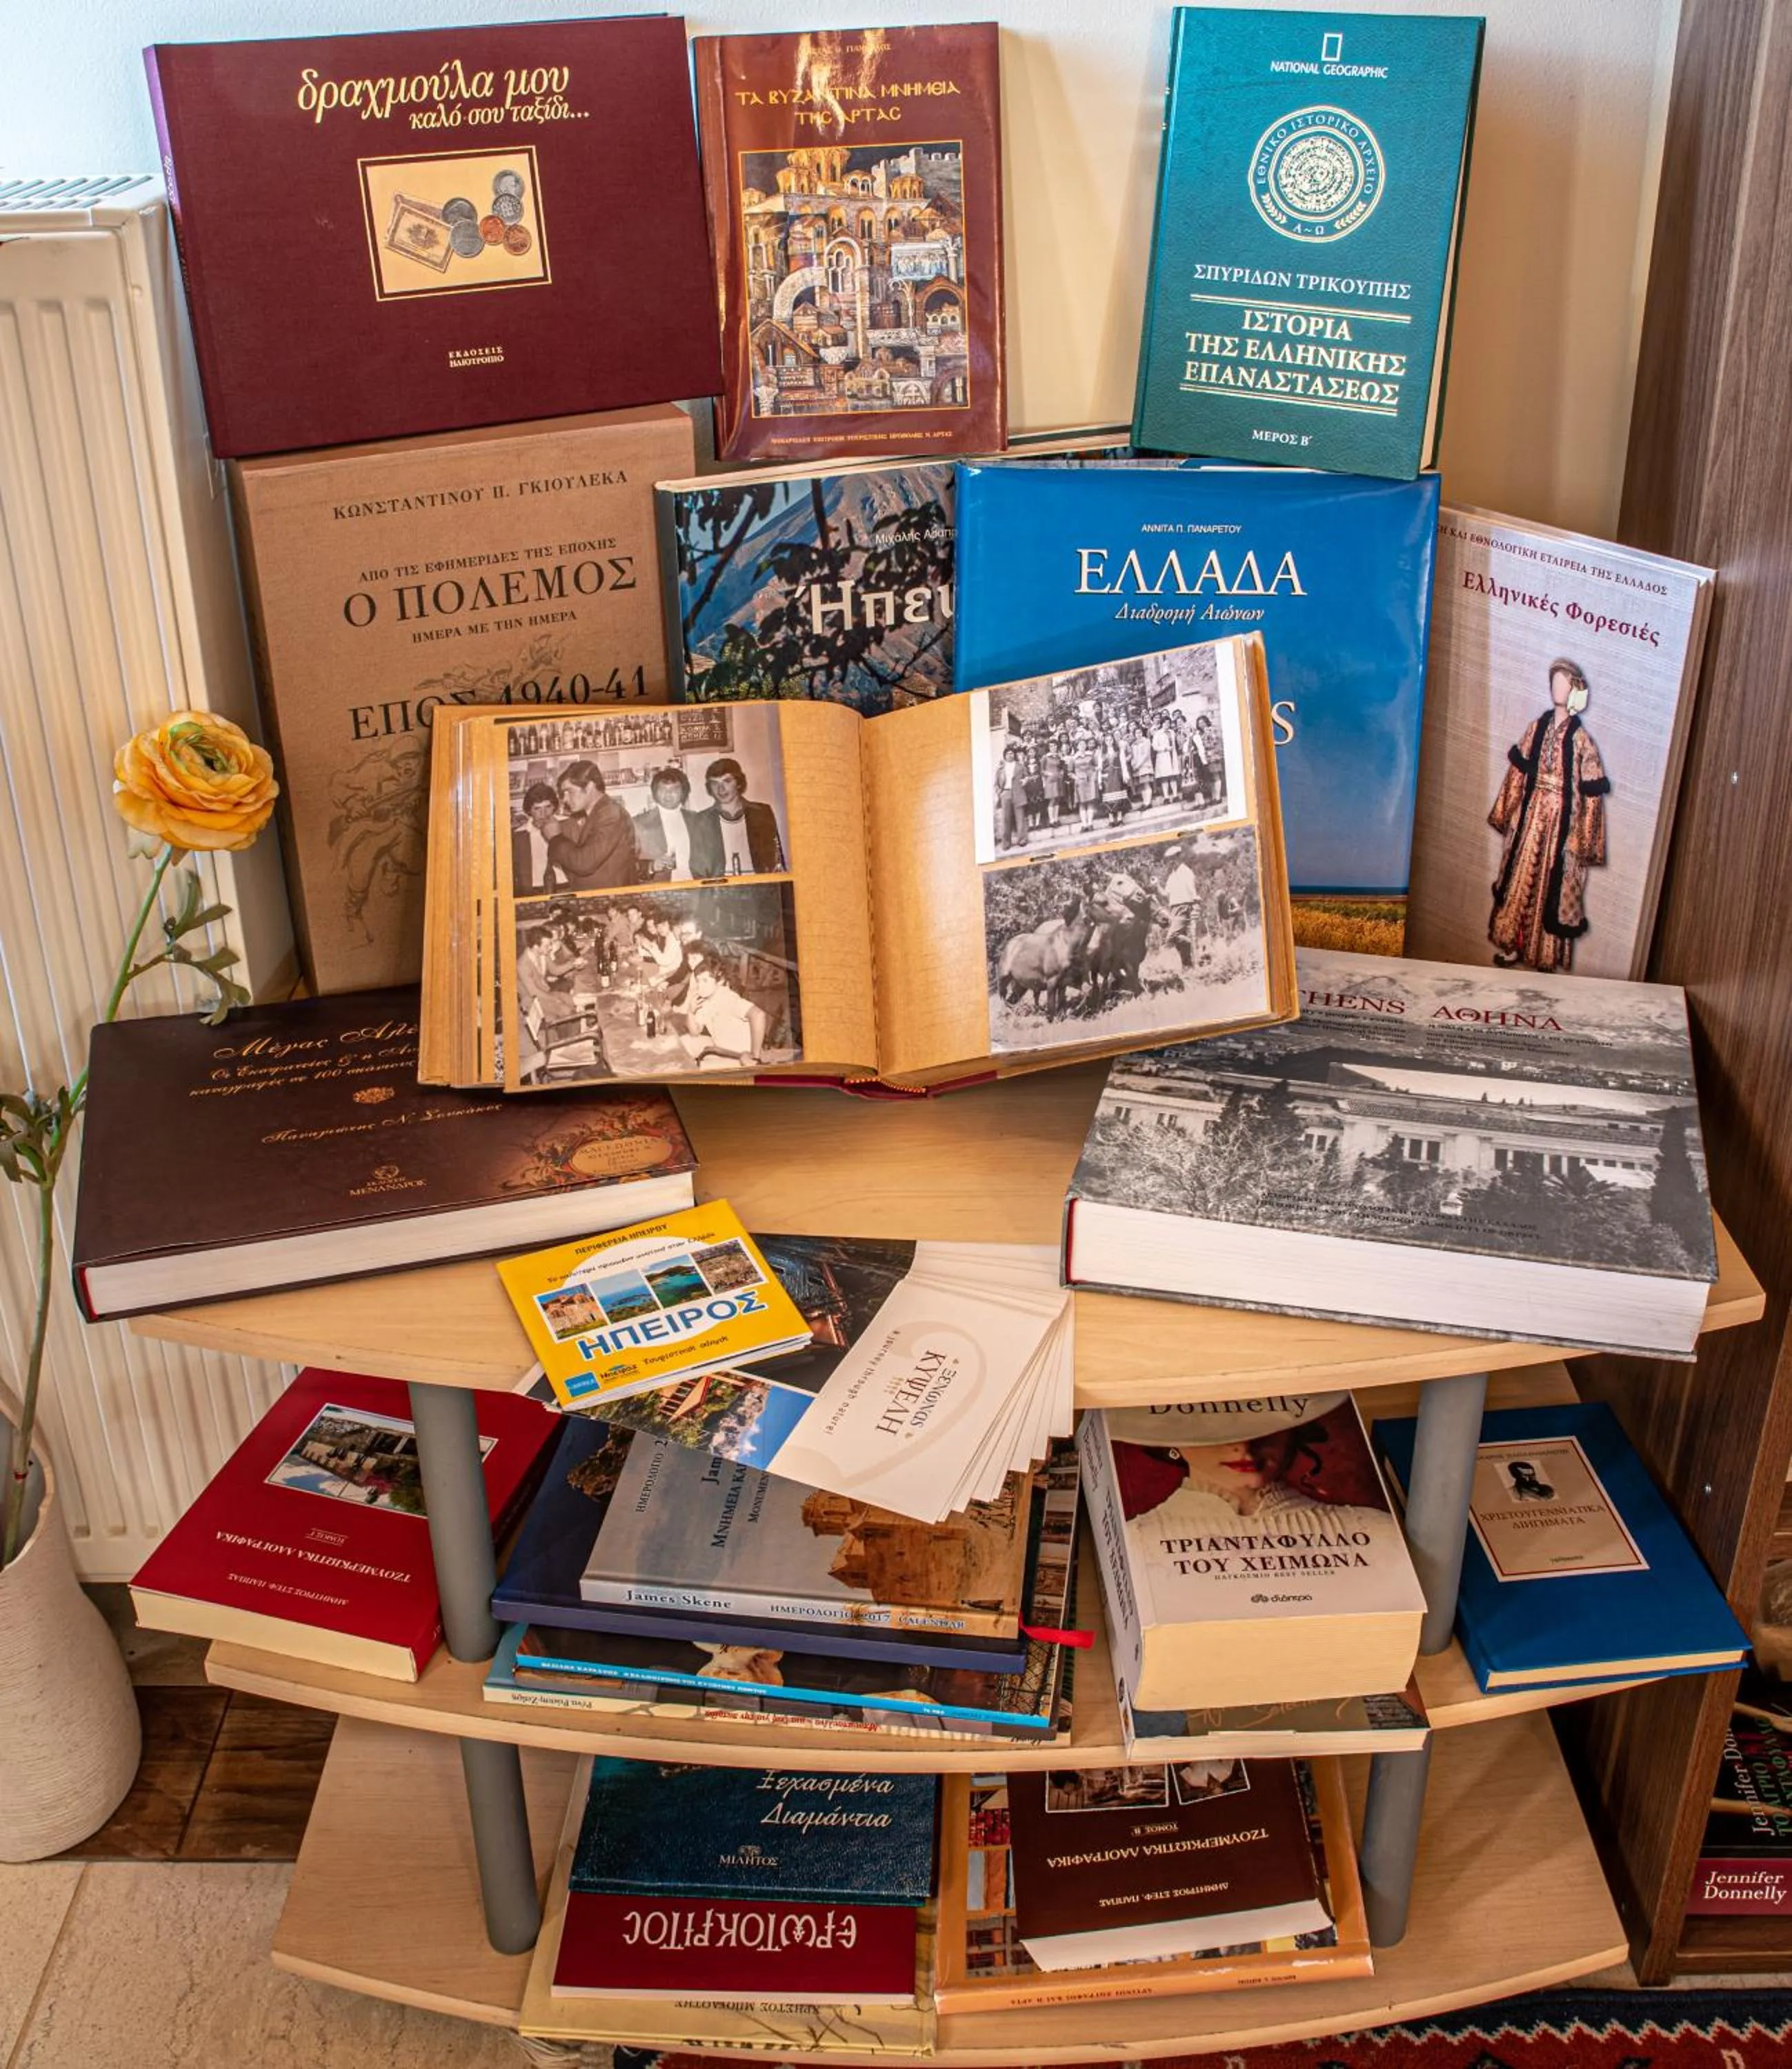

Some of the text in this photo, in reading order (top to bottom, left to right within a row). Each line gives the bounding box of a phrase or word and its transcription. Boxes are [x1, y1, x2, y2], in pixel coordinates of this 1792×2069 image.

[1271, 60, 1388, 78] NATIONAL GEOGRAPHIC
[297, 59, 570, 123] δραχμούλα μου
[735, 92, 764, 106] ΤΑ
[410, 101, 463, 129] καλό
[468, 105, 504, 125] σου
[1256, 114, 1377, 194] ΕΘΝΙΚΟ ΙΣΤΟΡΙΚΟ ΑΡΧΕΙΟ
[1194, 264, 1411, 299] ΣΠΥΡΙΔΩΝ ΤΡΙΚΟΥΠΗΣ
[1242, 310, 1353, 341] ΙΣΤΟΡΙΑ
[448, 346, 503, 359] ΕΚΔΟΣΕΙΣ
[1186, 332, 1406, 377] ΤΗΣ ΕΛΛΗΝΙΚΗΣ
[1184, 360, 1400, 406] ΕΠΑΝΑΣΤΑΣΕΩΣ
[1252, 430, 1297, 445] ΜΕΡΟΣ
[332, 470, 628, 520] ΚΩΝΣΤΑΝΤΙΝΟΥ Π. ΓΚΙΟΥΛΕΚΑ
[1142, 523, 1174, 532] ΑΝΝΙΤΑ
[1187, 524, 1242, 534] ΠΑΝΑΡΕΤΟΥ
[358, 537, 617, 583] ΑΠΟ ΤΙΣ ΕΦΗΜΕΡΙΔΕΣ ΤΗΣ ΕΠΟΧΗΣ
[1074, 548, 1308, 596] ΕΛΛΑΔΑ
[1449, 528, 1668, 596] ΚΑΙ ΕΘΝΟΛΟΓΙΚΗ ΕΤΑΙΡΕΙΑ ΤΗΣ ΕΛΛΑΔΟΣ
[344, 556, 637, 628] Ο ΠΟΛΕΜΟΣ
[1114, 602, 1264, 626] Διαδρομή Αιώνων
[1462, 570, 1661, 648] Ελληνικές Φορεσιές
[412, 610, 577, 644] ΗΜΕΡΑ ΜΕ ΤΗΝ ΗΜΕΡΑ
[498, 664, 650, 706] 1940-41
[1432, 1006, 1564, 1031] ΑΘΗΝΑ
[574, 1223, 668, 1255] ΠΕΡΙΦΕΡΕΙΑ ΗΠΕΙΡΟΥ
[577, 1290, 767, 1361] ΗΠΕΙΡΟΣ
[875, 1349, 948, 1436] ΚΥΨΕΛΗ
[635, 1452, 665, 1513] ΗΜΕΡΟΛΟΓΙΟ
[1513, 1517, 1586, 1529] ΔΙΗΓΗΜΑΤΑ
[215, 1530, 297, 1557] ΛΑΟΓΡΑΦΙΚΑ
[1159, 1531, 1371, 1555] ΤΡΙΑΝΤΑΦΥΛΛΟ
[1173, 1552, 1370, 1576] ΤΟΥ ΧΕΙΜΩΝΑ
[625, 1590, 732, 1609] James Skene
[770, 1603, 853, 1620] ΗΜΕΡΟΛΟΓΙΟ
[862, 1612, 890, 1623] 2017
[757, 1770, 895, 1796] Ξεχασμένα
[1733, 1764, 1776, 1837] Jennifer
[760, 1801, 893, 1834] Διαμάντια
[719, 1854, 779, 1866] ΜΙΛΗΤΟΣ
[1046, 1827, 1270, 1869] ΤΖΟΥΜΕΡΚΙΩΤΙΚΑ ΛΑΟΓΡΑΦΙΚΑ
[1172, 1881, 1229, 1897] ΔΗΜΗΤΡΙΟΣ
[1704, 1870, 1784, 1886] Jennifer
[1703, 1883, 1787, 1905] Donnelly
[759, 2002, 821, 2015] ΧΡΗΣΤΟΣ
